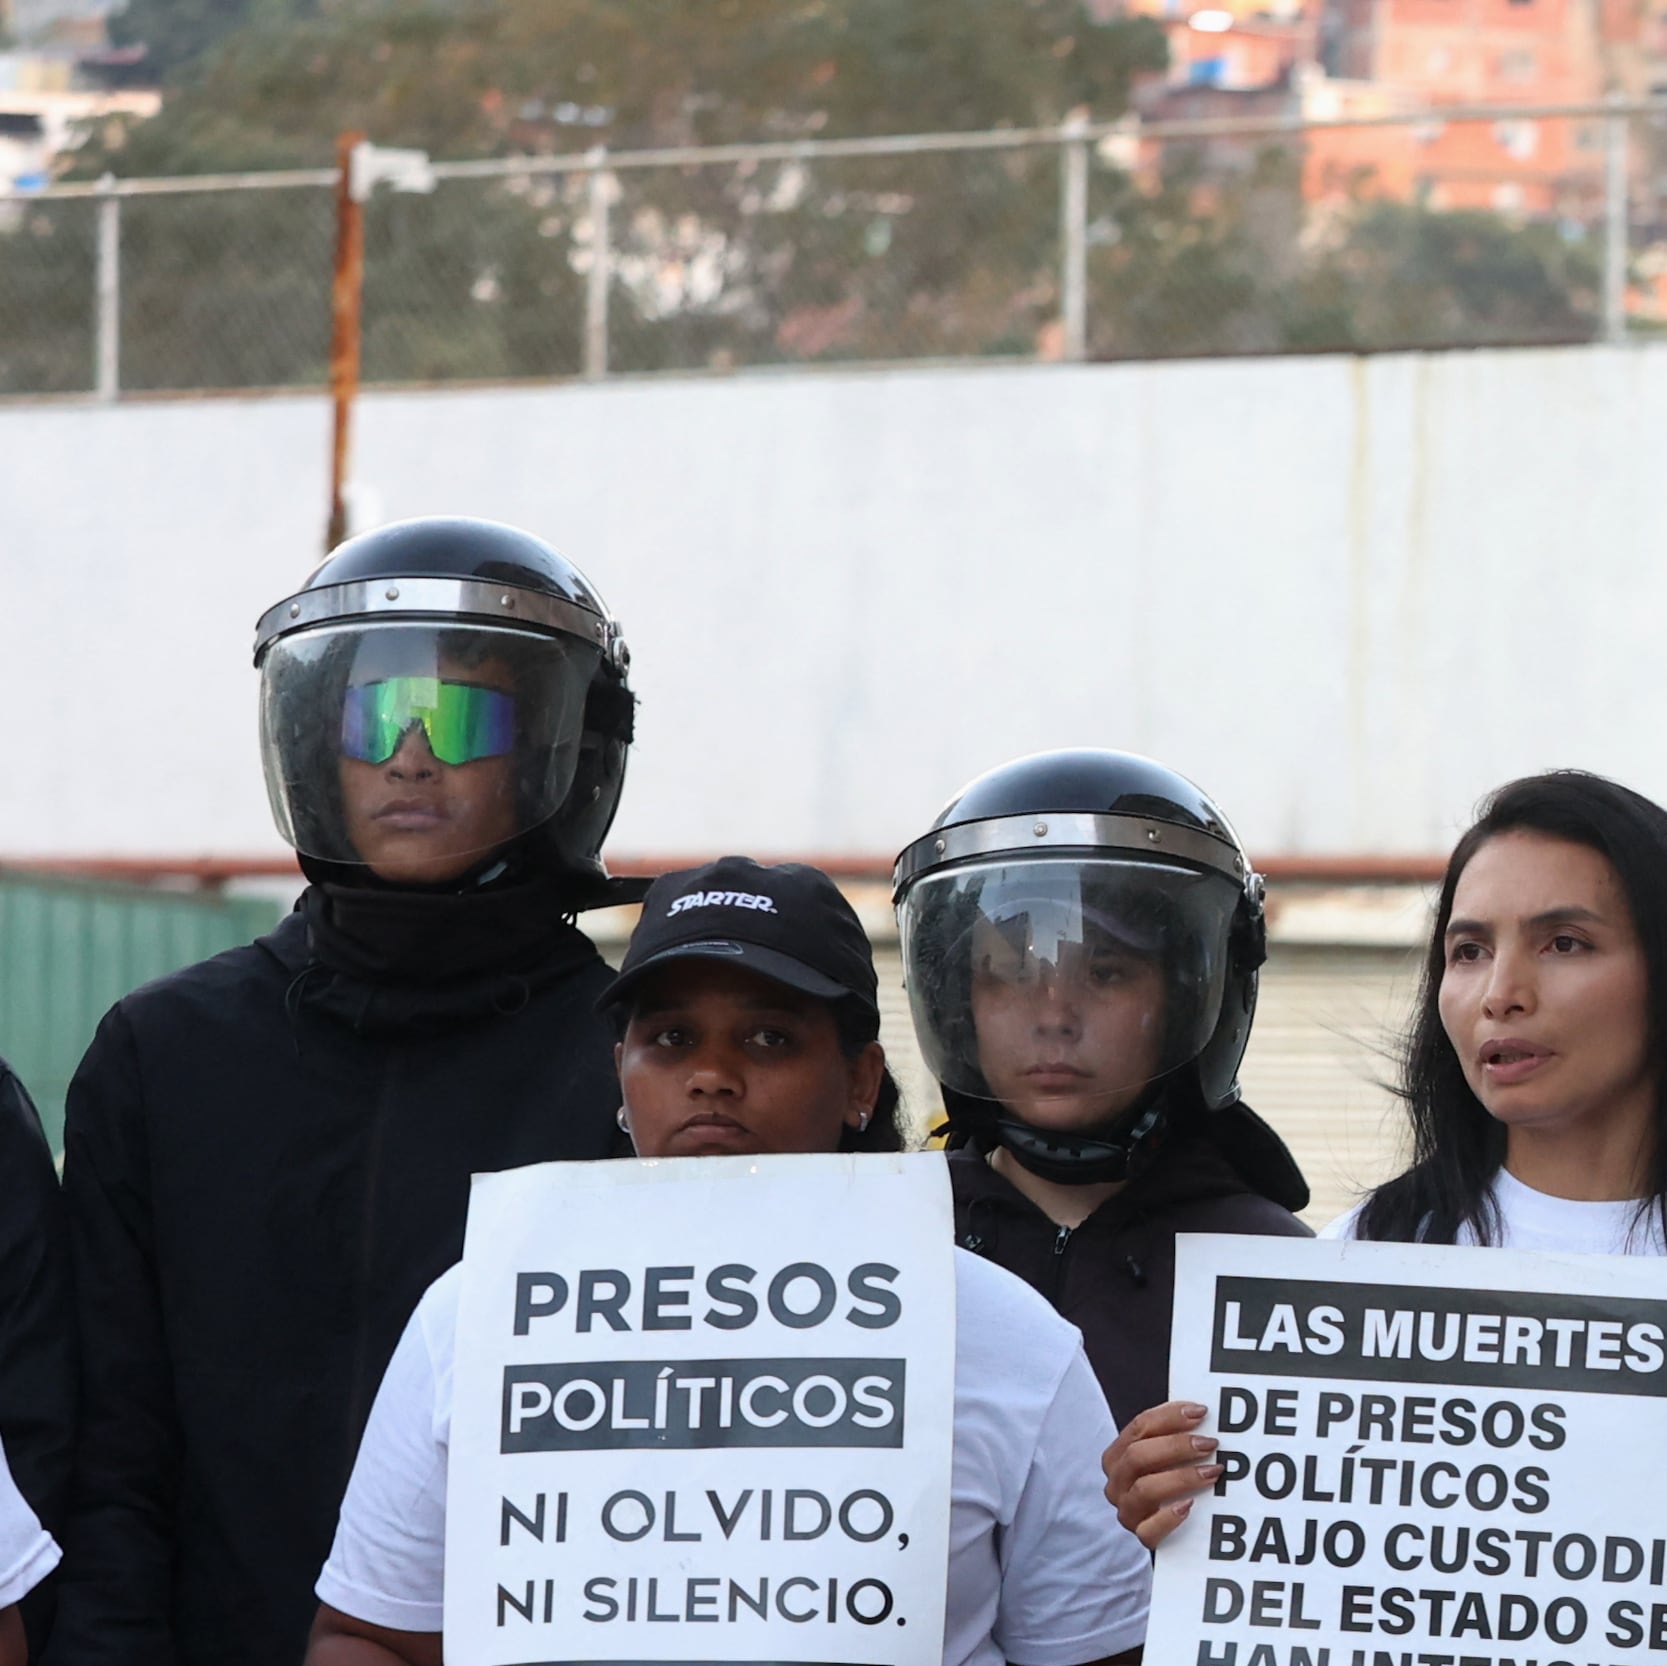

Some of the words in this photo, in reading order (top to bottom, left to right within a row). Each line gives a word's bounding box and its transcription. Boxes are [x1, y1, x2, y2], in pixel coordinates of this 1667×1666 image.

[666, 890, 774, 917] STARTER
[513, 1262, 902, 1336] PRESOS
[1222, 1301, 1344, 1355] LAS
[1361, 1308, 1665, 1374] MUERTES
[507, 1366, 896, 1434] POLÍTICOS
[1217, 1386, 1298, 1438] DE
[1317, 1392, 1567, 1451] PRESOS
[1214, 1446, 1550, 1514] POLÍTICOS
[501, 1493, 567, 1547] NI
[601, 1488, 910, 1552] OLVIDO,
[1208, 1515, 1366, 1567] BAJO
[496, 1579, 553, 1627] NI
[583, 1576, 907, 1627] SILENCIO.
[1202, 1578, 1321, 1630] DEL
[1339, 1586, 1588, 1644] ESTADO
